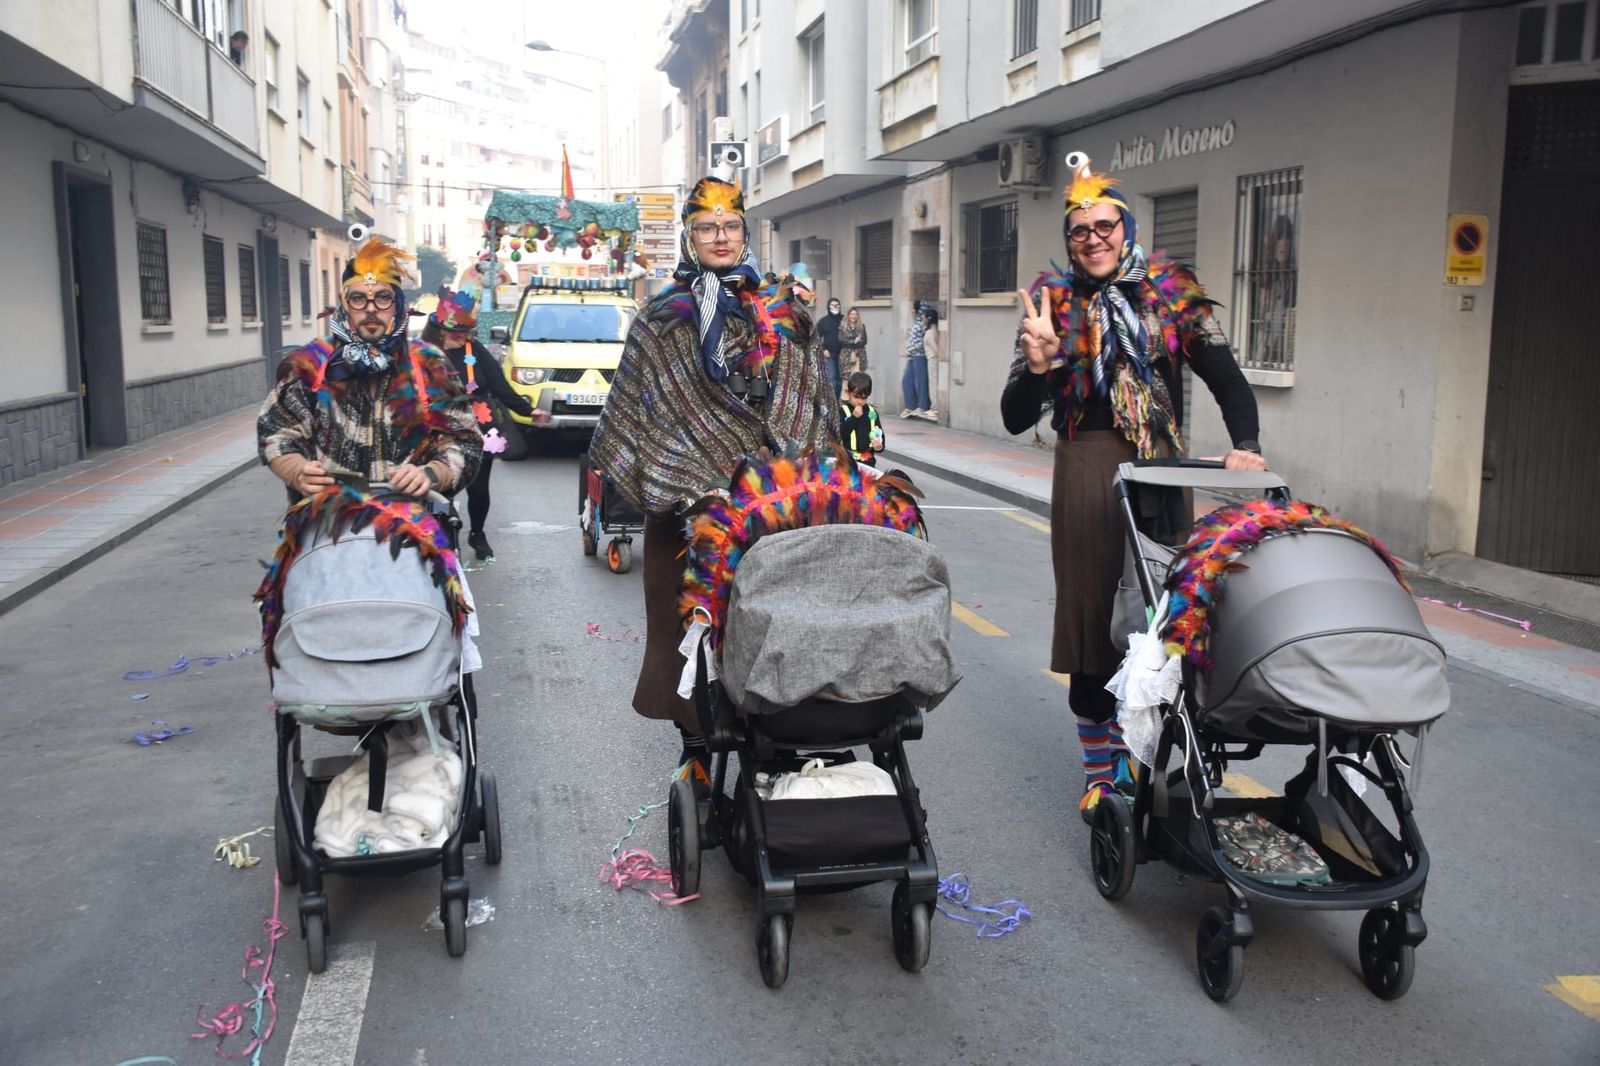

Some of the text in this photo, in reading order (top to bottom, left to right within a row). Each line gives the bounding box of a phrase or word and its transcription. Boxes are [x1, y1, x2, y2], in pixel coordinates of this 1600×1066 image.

[1110, 119, 1236, 172] Anita Moreno
[573, 394, 597, 404] 9340
